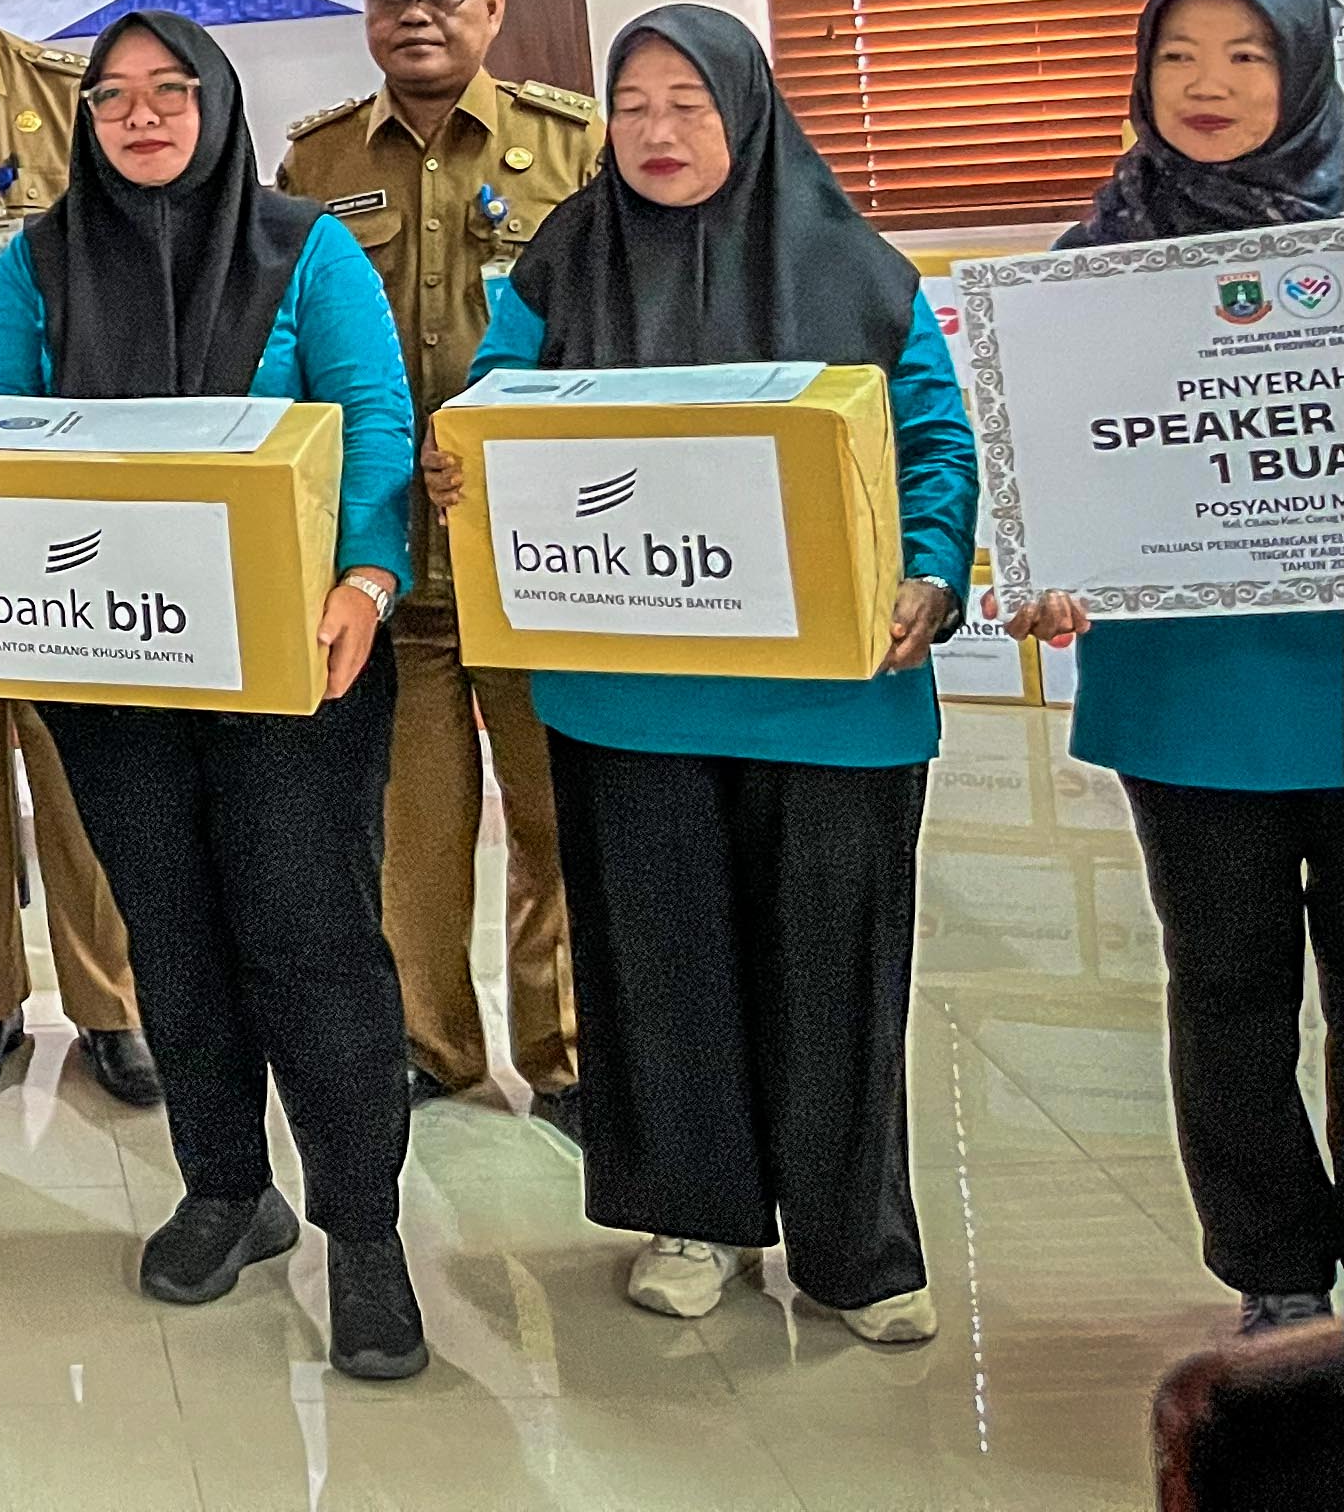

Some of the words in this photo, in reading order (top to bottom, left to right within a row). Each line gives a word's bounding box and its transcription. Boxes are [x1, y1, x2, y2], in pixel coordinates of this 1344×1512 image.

[1090, 402, 1336, 450] SPEAKER
[1210, 453, 1231, 484] 1
[1195, 494, 1325, 518] POSYANDU
[1141, 541, 1203, 554] EVALUASI
[1207, 534, 1318, 551] PERKEMBANGAN
[1250, 549, 1305, 561] TINGKAT
[512, 531, 630, 576] bank
[643, 533, 733, 587] bjb
[1281, 561, 1326, 572] TAHUN
[514, 589, 566, 603] KANTOR
[569, 592, 625, 606] CABANG
[628, 595, 683, 608] KHUSUS
[686, 597, 743, 610] BANTEN
[106, 590, 187, 641] bjb
[38, 644, 89, 657] CABANG
[92, 647, 141, 660] KHUSUS
[144, 650, 194, 663] BANTEN
